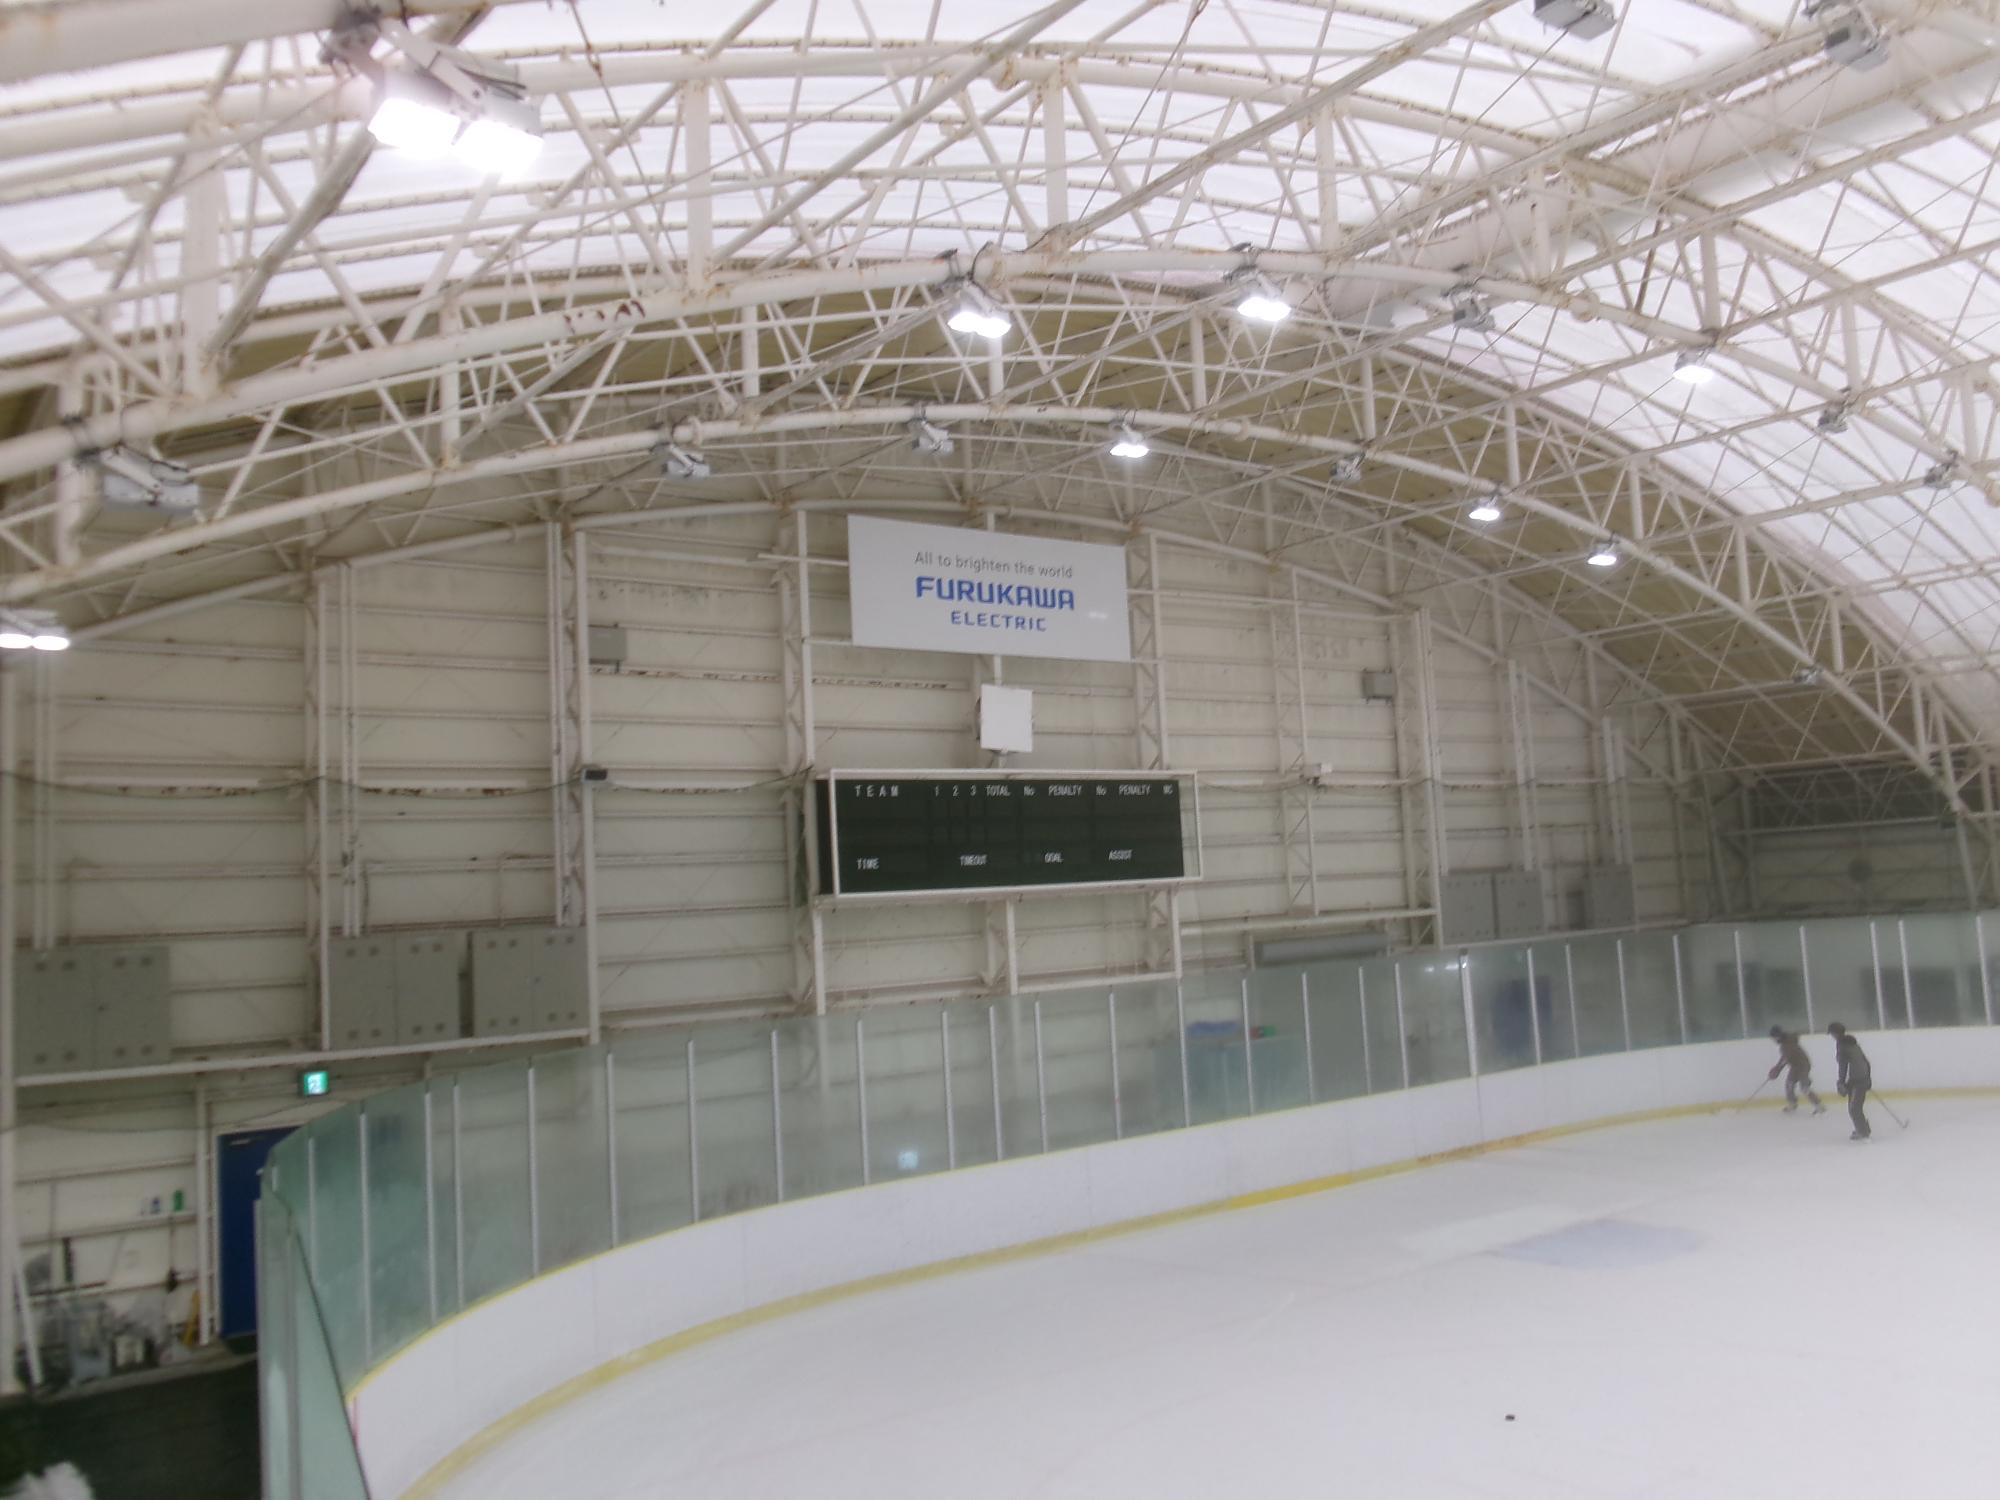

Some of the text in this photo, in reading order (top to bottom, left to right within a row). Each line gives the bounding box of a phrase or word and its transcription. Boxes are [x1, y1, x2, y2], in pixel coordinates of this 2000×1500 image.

[915, 551, 1073, 578] All to brighten the world
[916, 576, 1075, 610] FURUKAWA
[951, 611, 1046, 631] ELECTRIC
[953, 785, 959, 797] 2
[970, 785, 977, 796] 3
[986, 785, 1011, 797] TOTAL
[1048, 784, 1083, 796] PENALTY
[1118, 785, 1151, 796] PENALTY
[857, 858, 879, 870] TIME
[1044, 852, 1064, 863] GOAL
